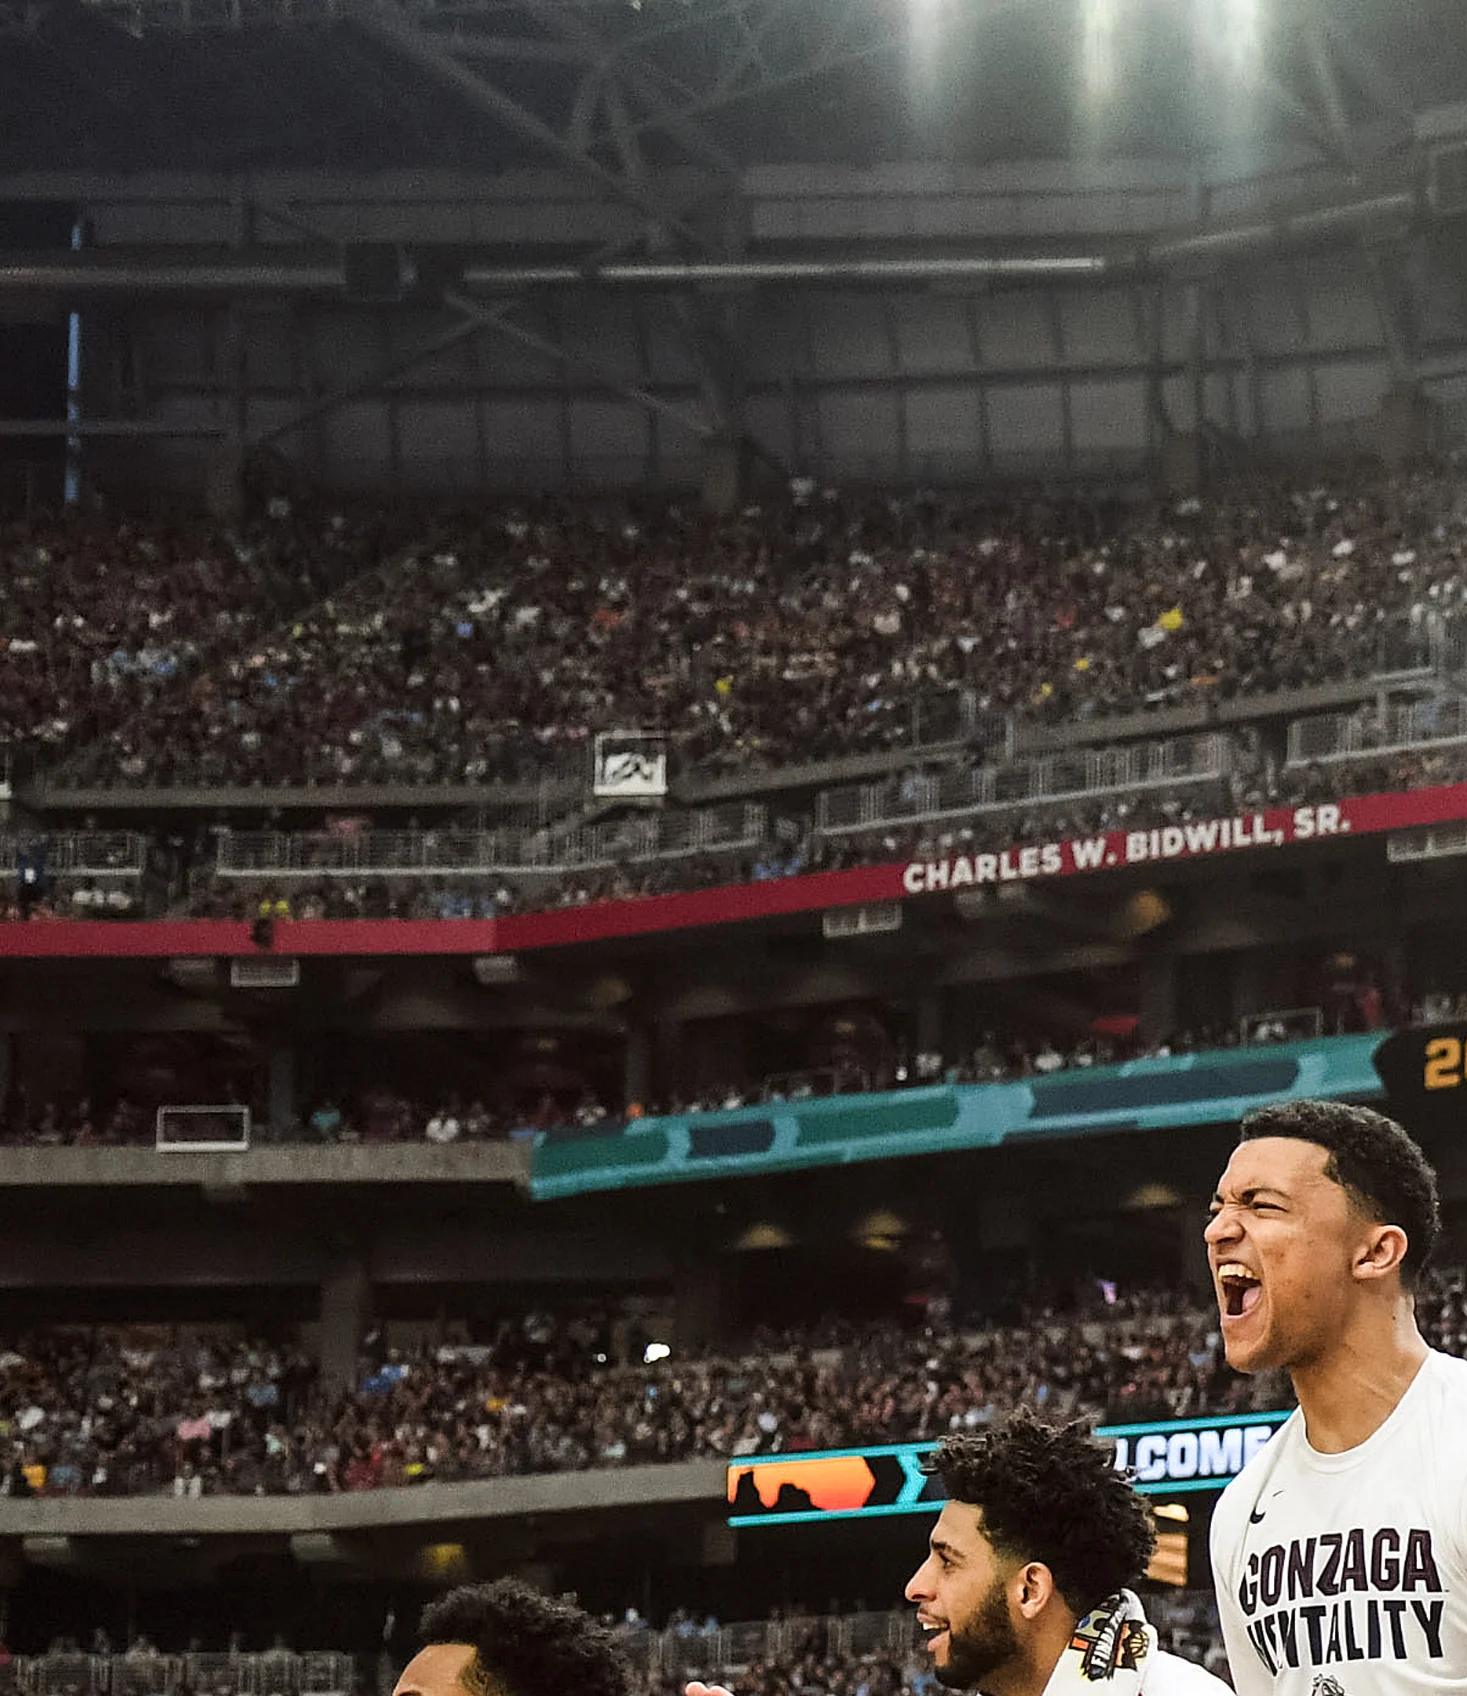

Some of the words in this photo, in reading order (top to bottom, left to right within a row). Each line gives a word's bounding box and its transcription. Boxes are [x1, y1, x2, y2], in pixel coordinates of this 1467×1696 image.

[903, 842, 1062, 895] CHARLES
[1071, 834, 1119, 871] W.
[1125, 813, 1285, 864] BIDWILL,
[1293, 803, 1352, 840] SR.
[1239, 1528, 1444, 1617] GONZAGA
